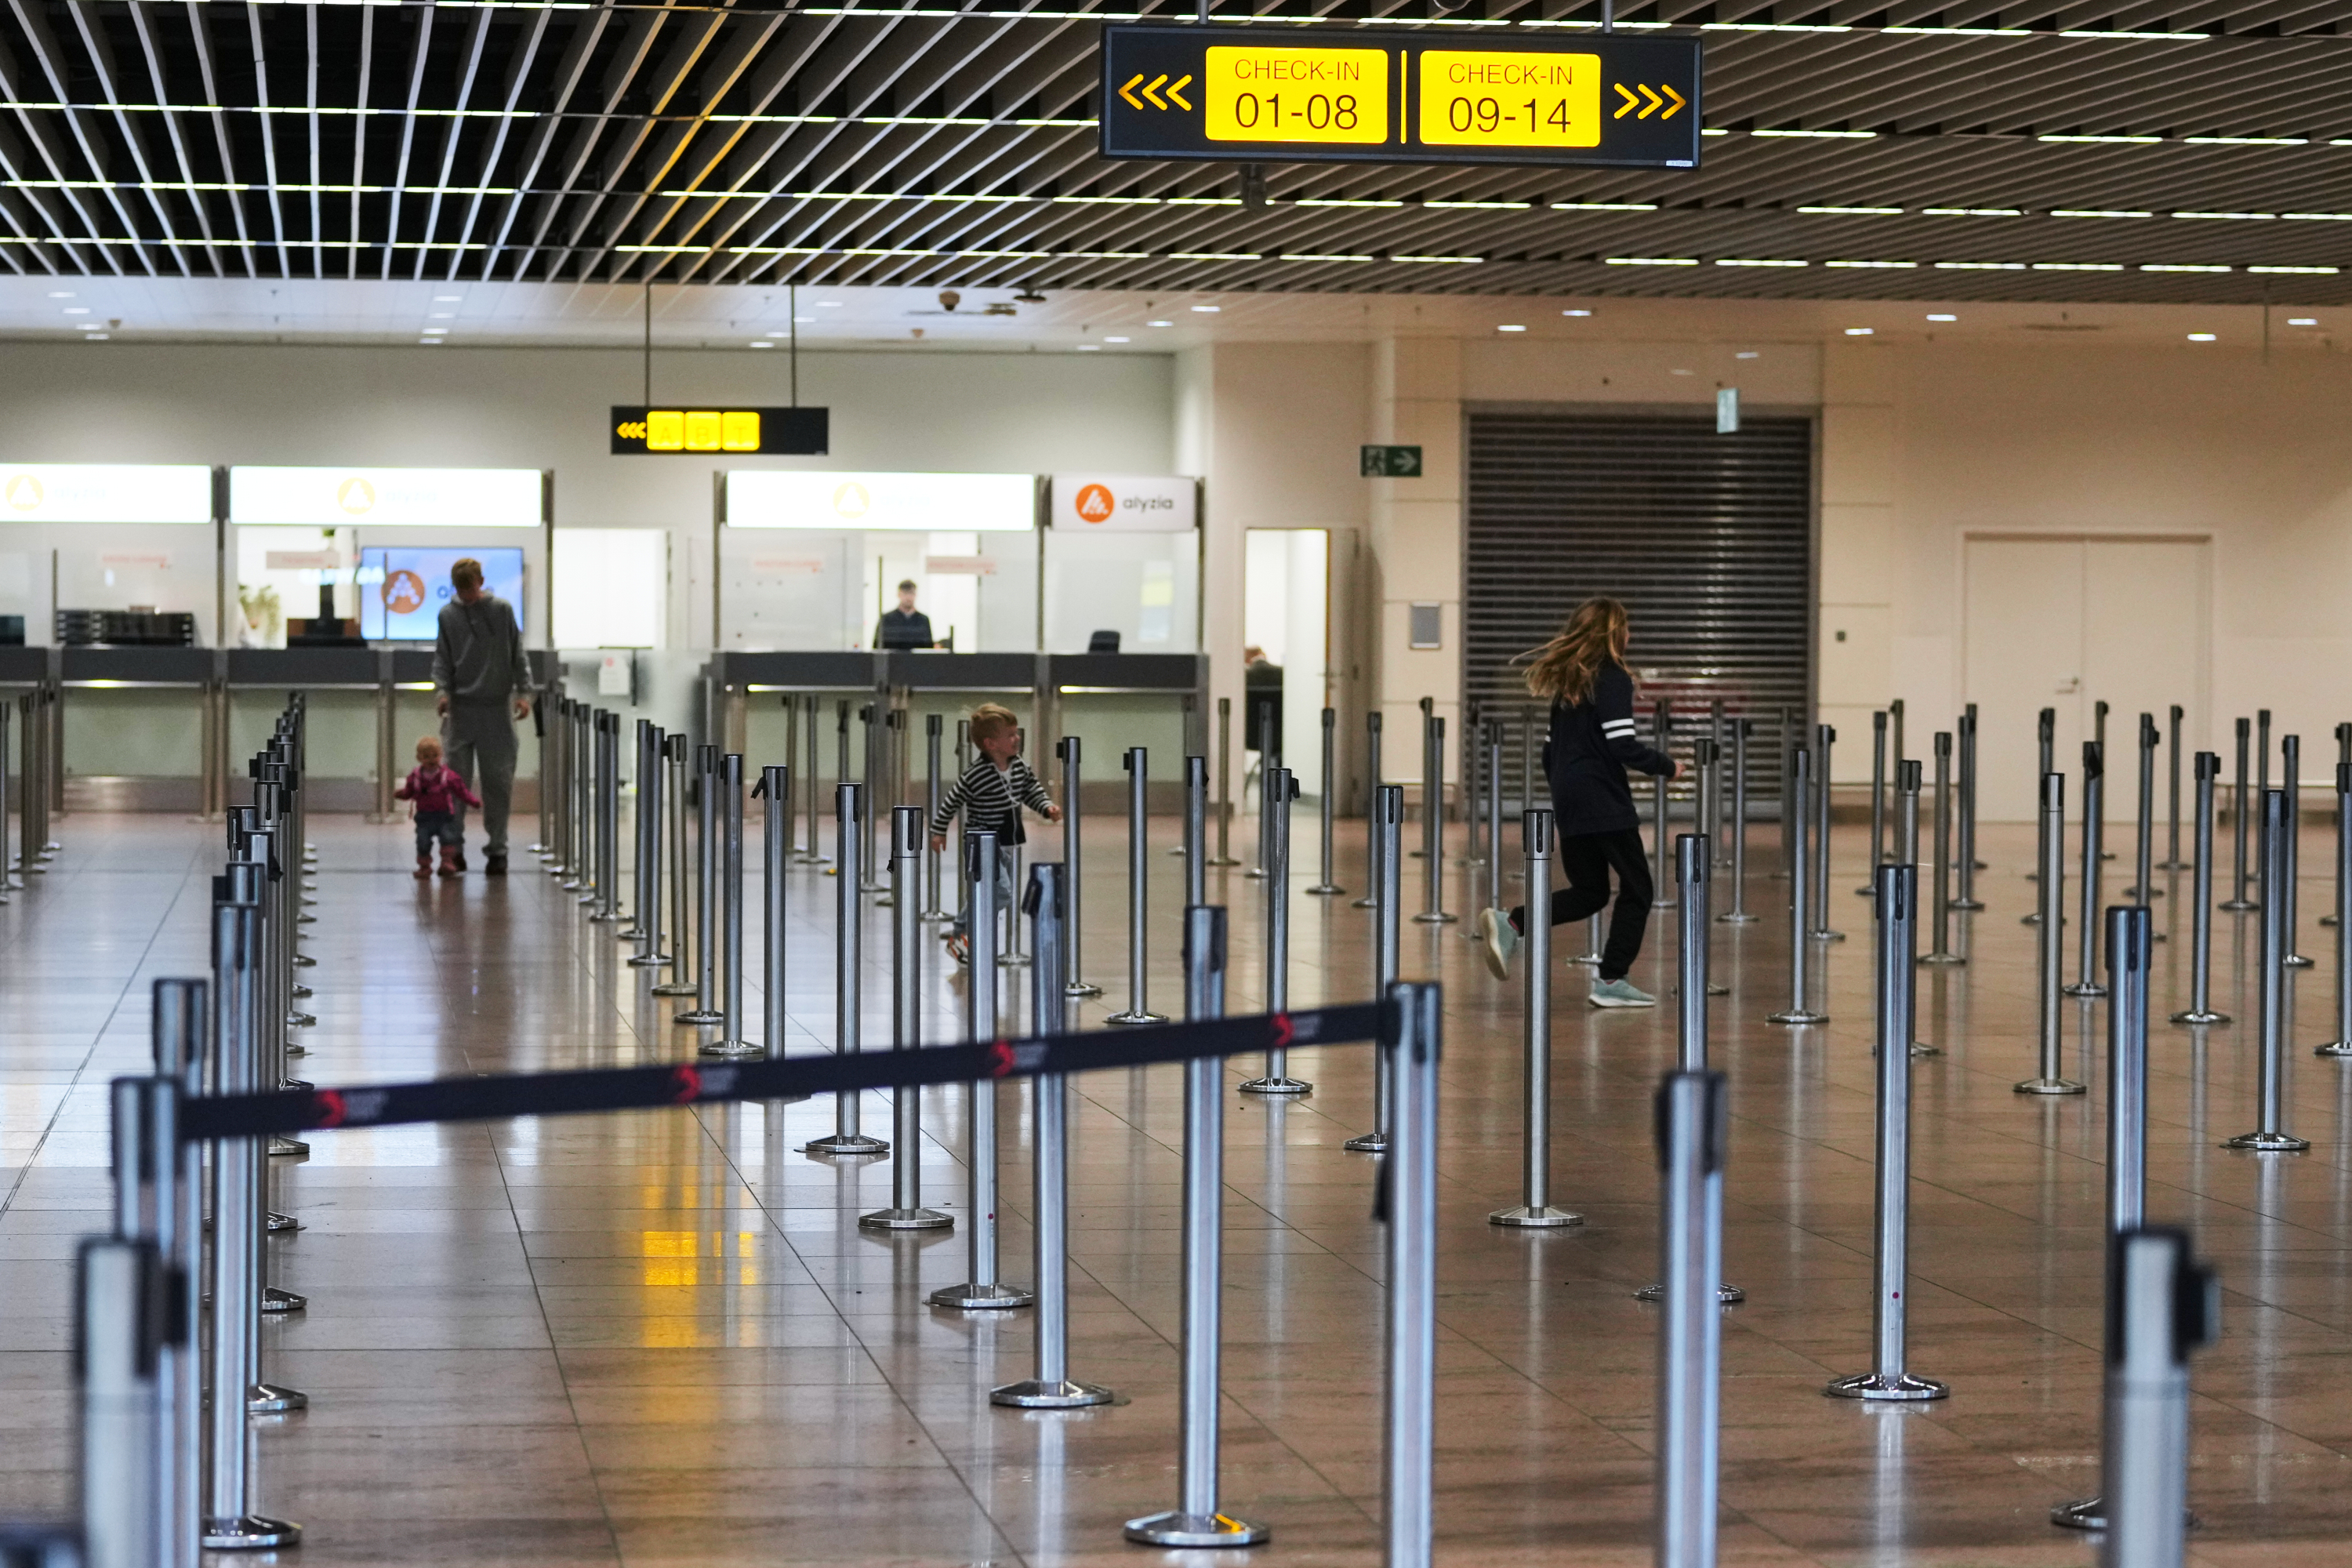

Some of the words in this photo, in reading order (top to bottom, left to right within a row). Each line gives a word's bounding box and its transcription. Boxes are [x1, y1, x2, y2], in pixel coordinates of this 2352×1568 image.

[1235, 59, 1359, 82] CHECK-IN
[1449, 63, 1572, 85] CHECK-IN
[1235, 93, 1359, 130] 01-08
[1449, 96, 1571, 133] 09-14
[1123, 495, 1174, 514] alyzia
